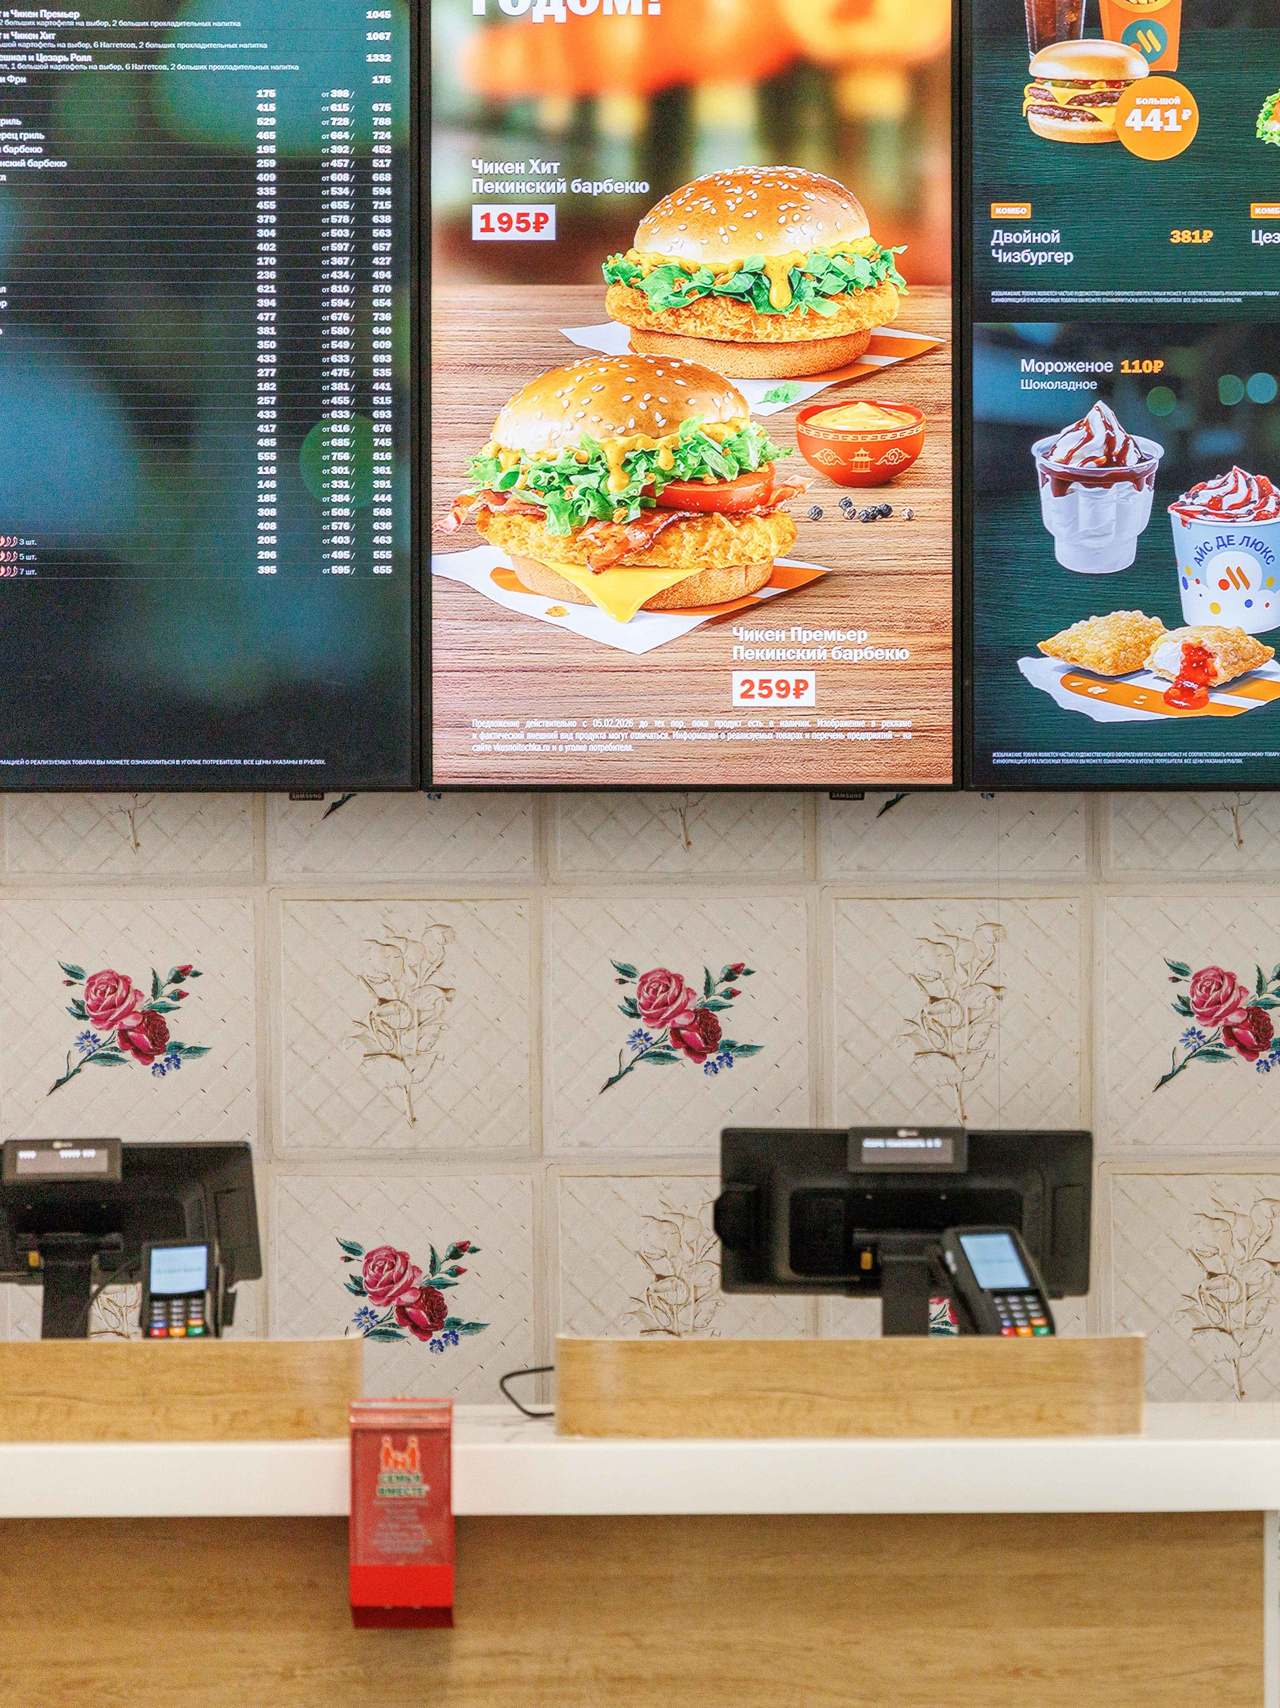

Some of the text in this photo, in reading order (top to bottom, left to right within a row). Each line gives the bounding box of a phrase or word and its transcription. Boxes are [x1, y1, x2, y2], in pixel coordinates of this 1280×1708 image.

[10, 9, 391, 20] Чикен Премьер 1045
[10, 31, 391, 40] Чикен Хит 1067
[36, 53, 391, 63] Цезарь Ролл 1332
[6, 75, 26, 85] Фри
[1136, 96, 1180, 105] БОЛЬШОЙ
[373, 117, 391, 125] 788
[1125, 109, 1192, 131] 441₽
[19, 131, 391, 141] гриль 465 724
[2, 145, 391, 155] барбекю 195 452
[27, 159, 391, 169] барбекю 259 517
[472, 159, 560, 174] Чикен Хит
[472, 178, 649, 196] Пекинский барбекю
[257, 201, 391, 209] 455 715
[479, 212, 549, 234] 195₽
[257, 229, 391, 237] 304 563
[991, 230, 1213, 246] Двойной 381₽
[992, 249, 1073, 265] Чизбургер
[257, 285, 392, 293] 621 870
[257, 313, 392, 321] 477 736
[1021, 359, 1164, 375] Мороженое 110₽
[1021, 379, 1097, 390] Шоколадное
[258, 452, 392, 460] 555 816
[258, 508, 392, 516] 308 568
[19, 538, 25, 546] 3
[258, 536, 277, 544] 205
[373, 536, 392, 544] 463
[258, 551, 277, 559] 296
[373, 551, 392, 559] 555
[1194, 535, 1275, 566] АЙС ДЕ ЛЮКС
[258, 566, 277, 574] 395
[373, 566, 392, 574] 655
[733, 627, 868, 645] Чикен Премьер
[732, 645, 910, 664] Пекинский барбекю
[739, 678, 810, 700] 259₽
[592, 719, 633, 728] 05.02.2026
